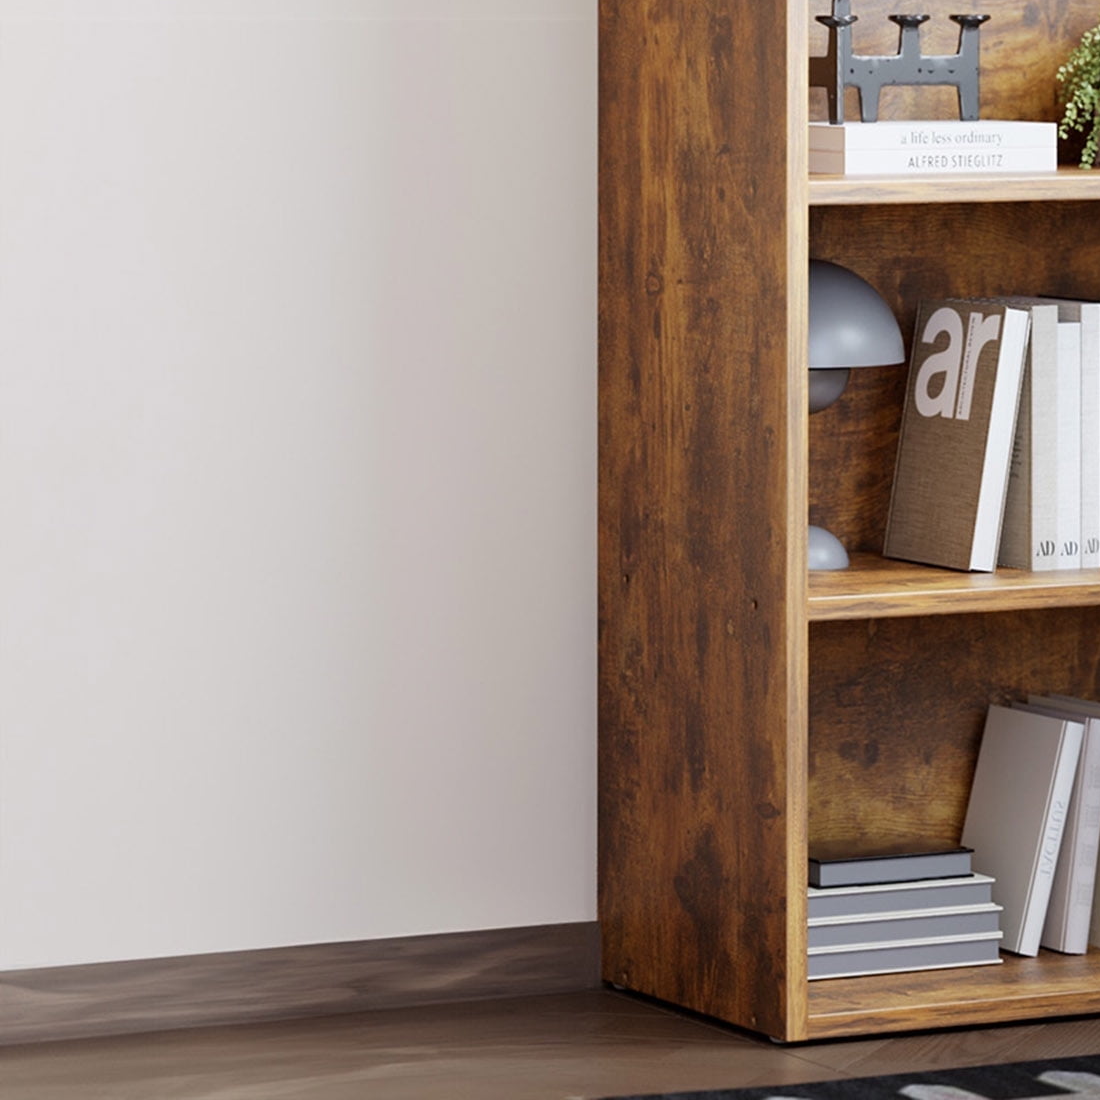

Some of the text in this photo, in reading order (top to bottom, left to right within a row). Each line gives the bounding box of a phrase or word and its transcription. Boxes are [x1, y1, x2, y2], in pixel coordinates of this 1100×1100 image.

[900, 130, 1003, 147] a life less ordinary
[907, 154, 1003, 168] ALFRED STIEGLITZ
[915, 307, 1001, 420] ar
[1036, 540, 1055, 557] AD
[1060, 541, 1079, 557] AD
[1085, 539, 1100, 555] AD
